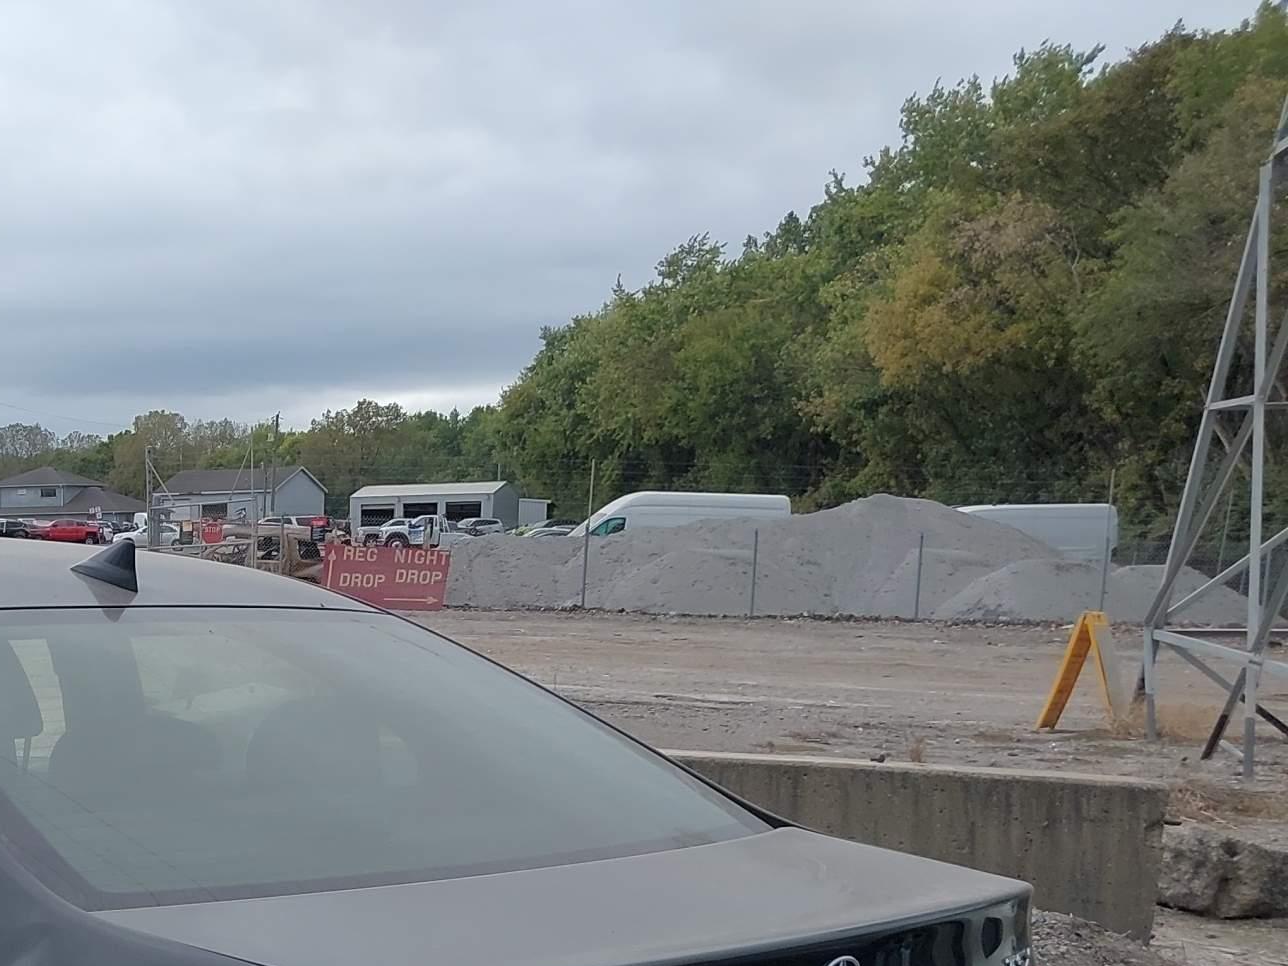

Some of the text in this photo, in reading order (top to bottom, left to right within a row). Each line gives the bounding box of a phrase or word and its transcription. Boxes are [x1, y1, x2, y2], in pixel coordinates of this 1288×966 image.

[343, 546, 449, 566] REG NIGHT
[339, 569, 443, 588] DROP DROP
